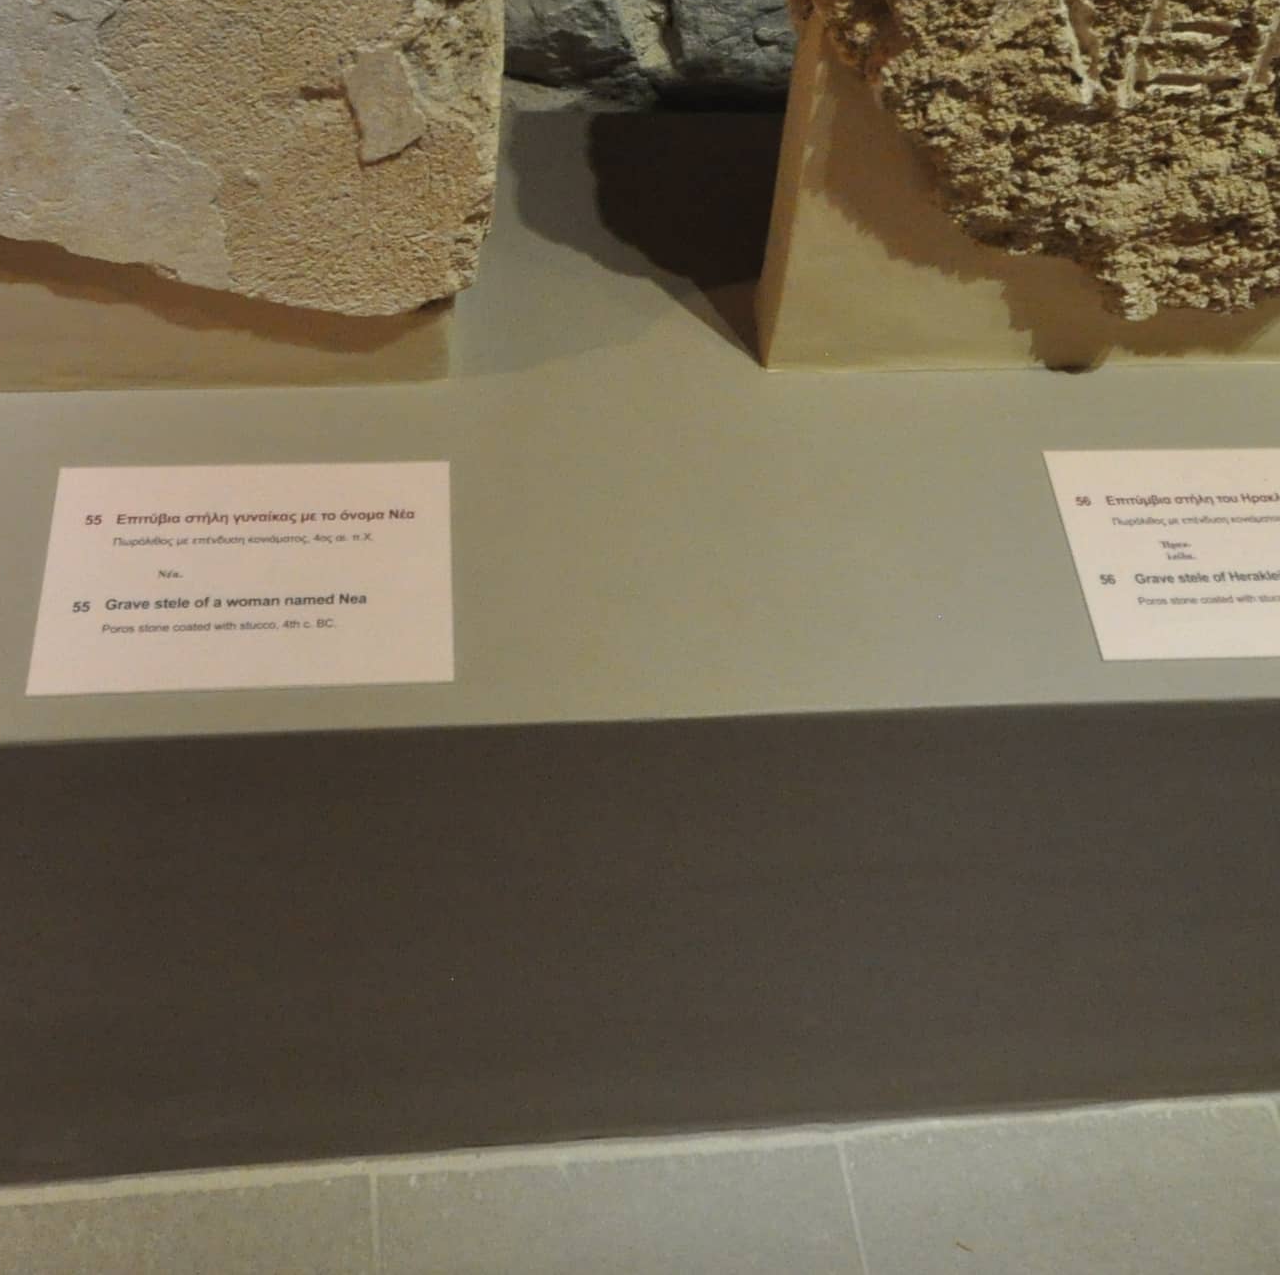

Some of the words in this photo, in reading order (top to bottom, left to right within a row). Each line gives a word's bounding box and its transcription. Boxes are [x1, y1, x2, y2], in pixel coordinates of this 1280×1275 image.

[1075, 495, 1092, 506] 56
[1173, 493, 1214, 506] στήλη
[1215, 494, 1239, 504] του
[85, 514, 102, 525] 55
[184, 510, 228, 525] στήλη
[233, 510, 297, 524] γυναίκας
[300, 511, 317, 523] με
[321, 511, 336, 521] το
[340, 509, 384, 521] όνομα
[388, 508, 415, 520] Νέα
[176, 536, 189, 547] με
[1099, 573, 1117, 585] 56
[1134, 573, 1175, 585] Grave
[1177, 572, 1209, 584] stele
[1212, 571, 1226, 583] of
[71, 601, 91, 613] 55
[104, 598, 150, 611] Grave
[153, 597, 190, 610] stele
[194, 596, 210, 609] of
[213, 598, 222, 608] a
[225, 597, 280, 607] woman
[283, 593, 335, 606] named
[338, 593, 368, 604] Nea
[101, 624, 135, 635] Poros
[137, 623, 170, 634] stone
[172, 621, 212, 633] coated
[213, 620, 237, 631] with
[282, 619, 301, 629] 4th
